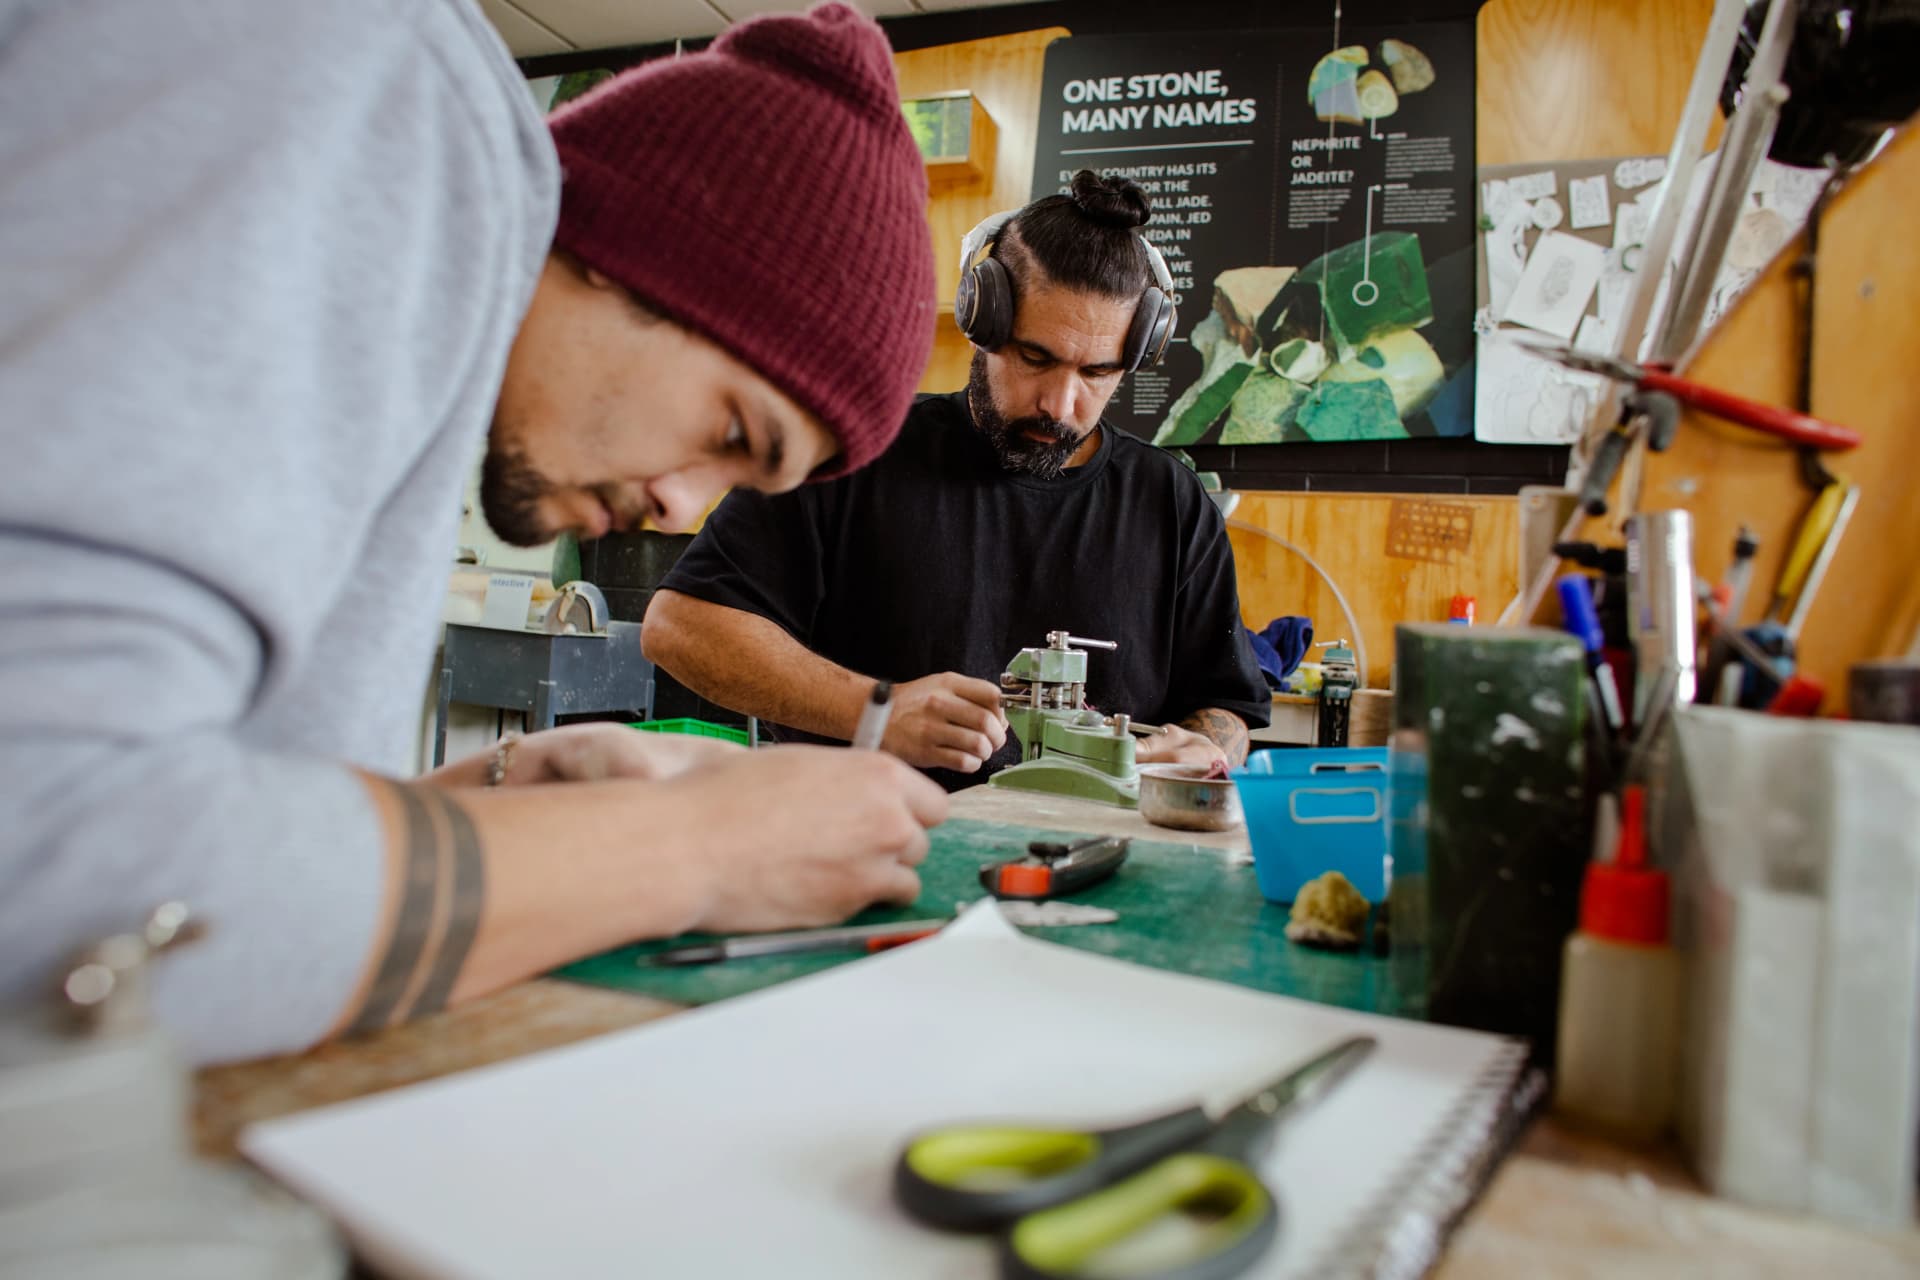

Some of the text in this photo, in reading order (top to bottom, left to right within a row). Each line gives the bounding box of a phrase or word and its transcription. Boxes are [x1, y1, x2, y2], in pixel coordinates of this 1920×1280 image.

[1063, 70, 1229, 103] ONE STONE,
[1062, 98, 1256, 134] MANY NAMES
[1292, 136, 1361, 152] NEPHRITE
[1291, 155, 1312, 168] OR
[1102, 162, 1217, 178] COUNTRY HAS ITS
[1290, 170, 1354, 185] JADEITE?
[1144, 180, 1190, 194] OR THE
[1150, 195, 1213, 209] ALL JADE.
[1144, 211, 1213, 225] PAIN, JED
[1176, 229, 1191, 240] IN
[1171, 261, 1192, 272] WE
